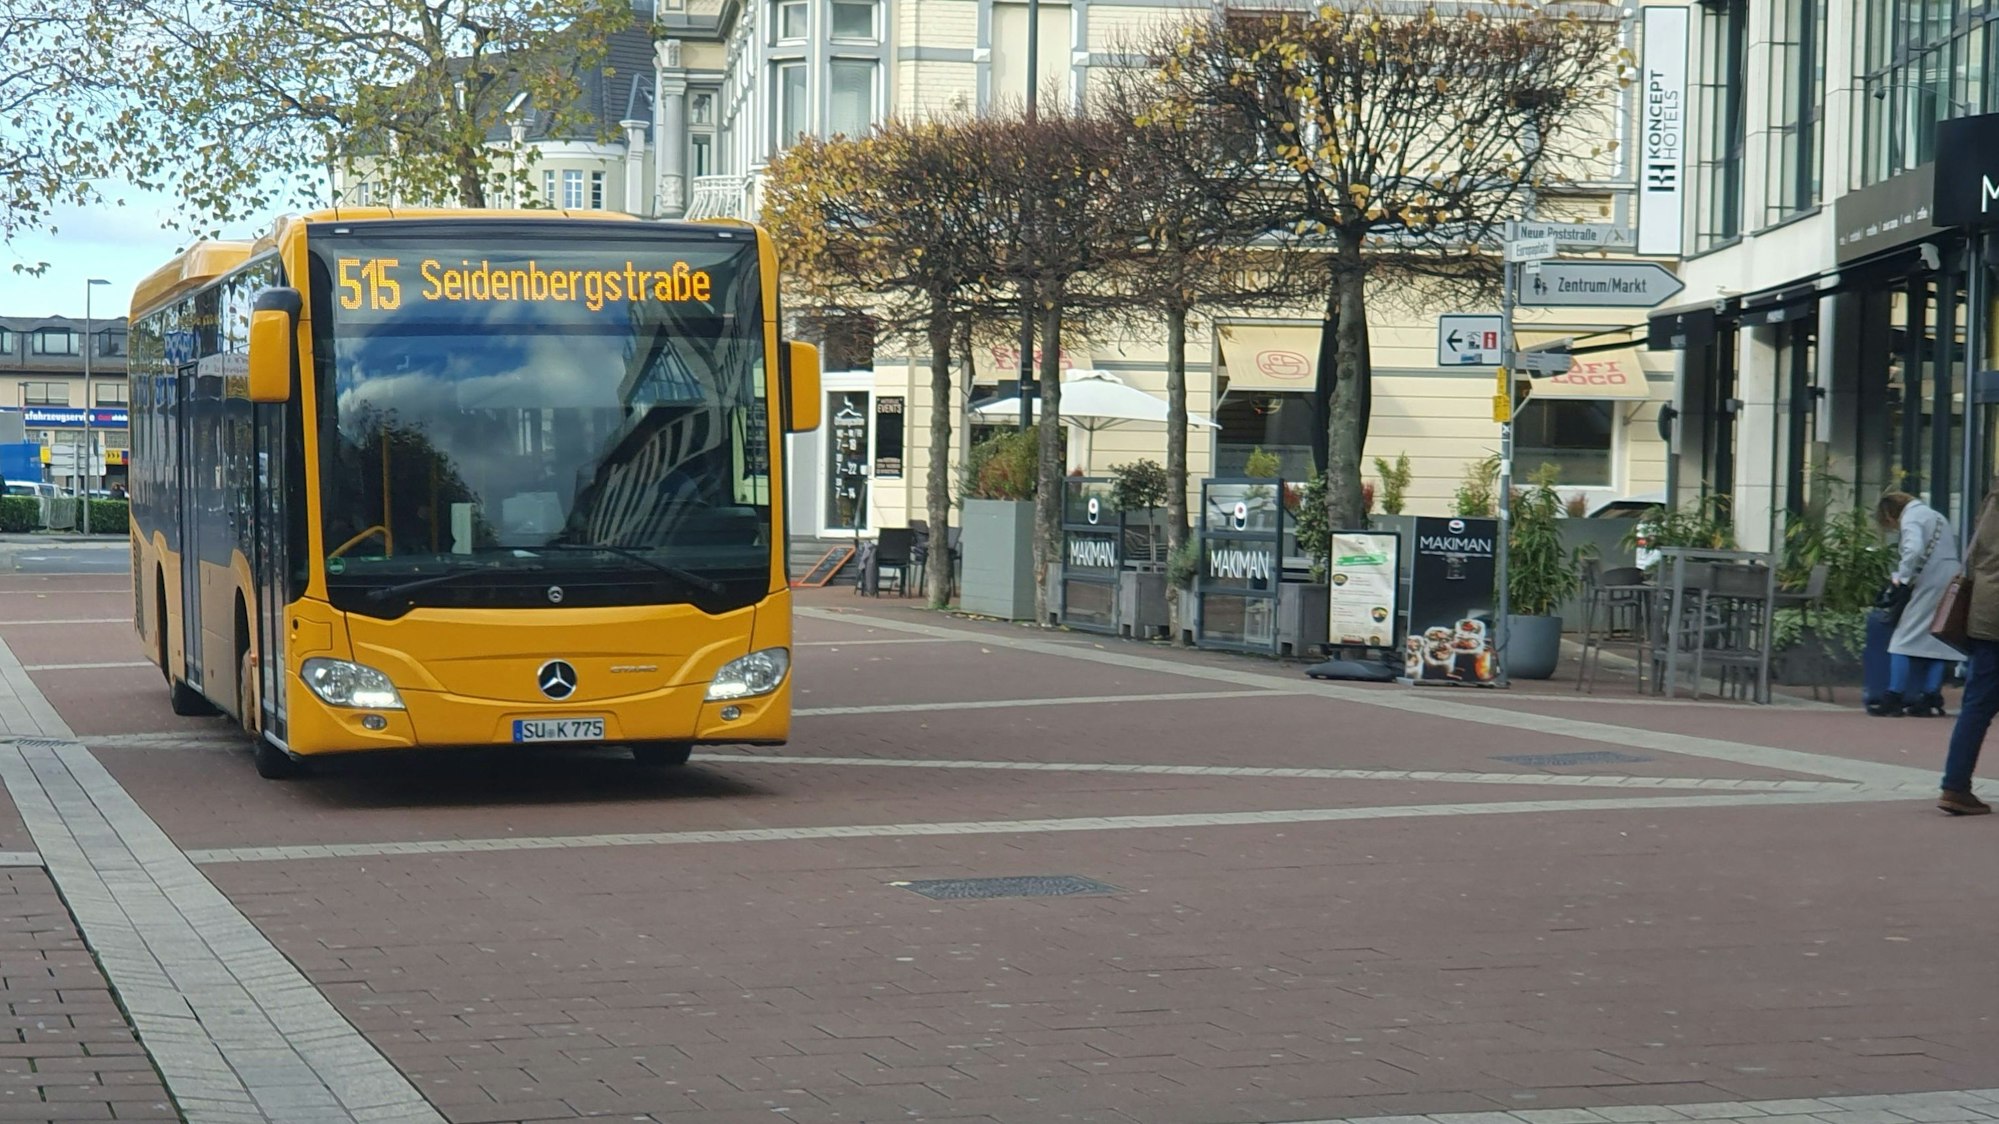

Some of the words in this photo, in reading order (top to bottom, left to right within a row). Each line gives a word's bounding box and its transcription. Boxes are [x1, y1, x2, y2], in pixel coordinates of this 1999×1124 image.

[1648, 70, 1664, 158] KONCEPT
[1662, 90, 1679, 159] HOTELS
[1520, 226, 1545, 238] Neue
[338, 258, 401, 310] 515
[421, 259, 711, 312] Seidenbergstraße
[1558, 277, 1647, 294] Zentrum/Markt
[24, 411, 95, 423] zfahrzeugservie
[877, 404, 902, 414] EVENTS
[1420, 536, 1491, 552] MAKIMAN
[1070, 541, 1115, 567] MAKIMAN
[1211, 551, 1269, 579] MAKIMAN
[524, 722, 546, 739] SU
[557, 721, 567, 738] K
[571, 720, 603, 737] 775
